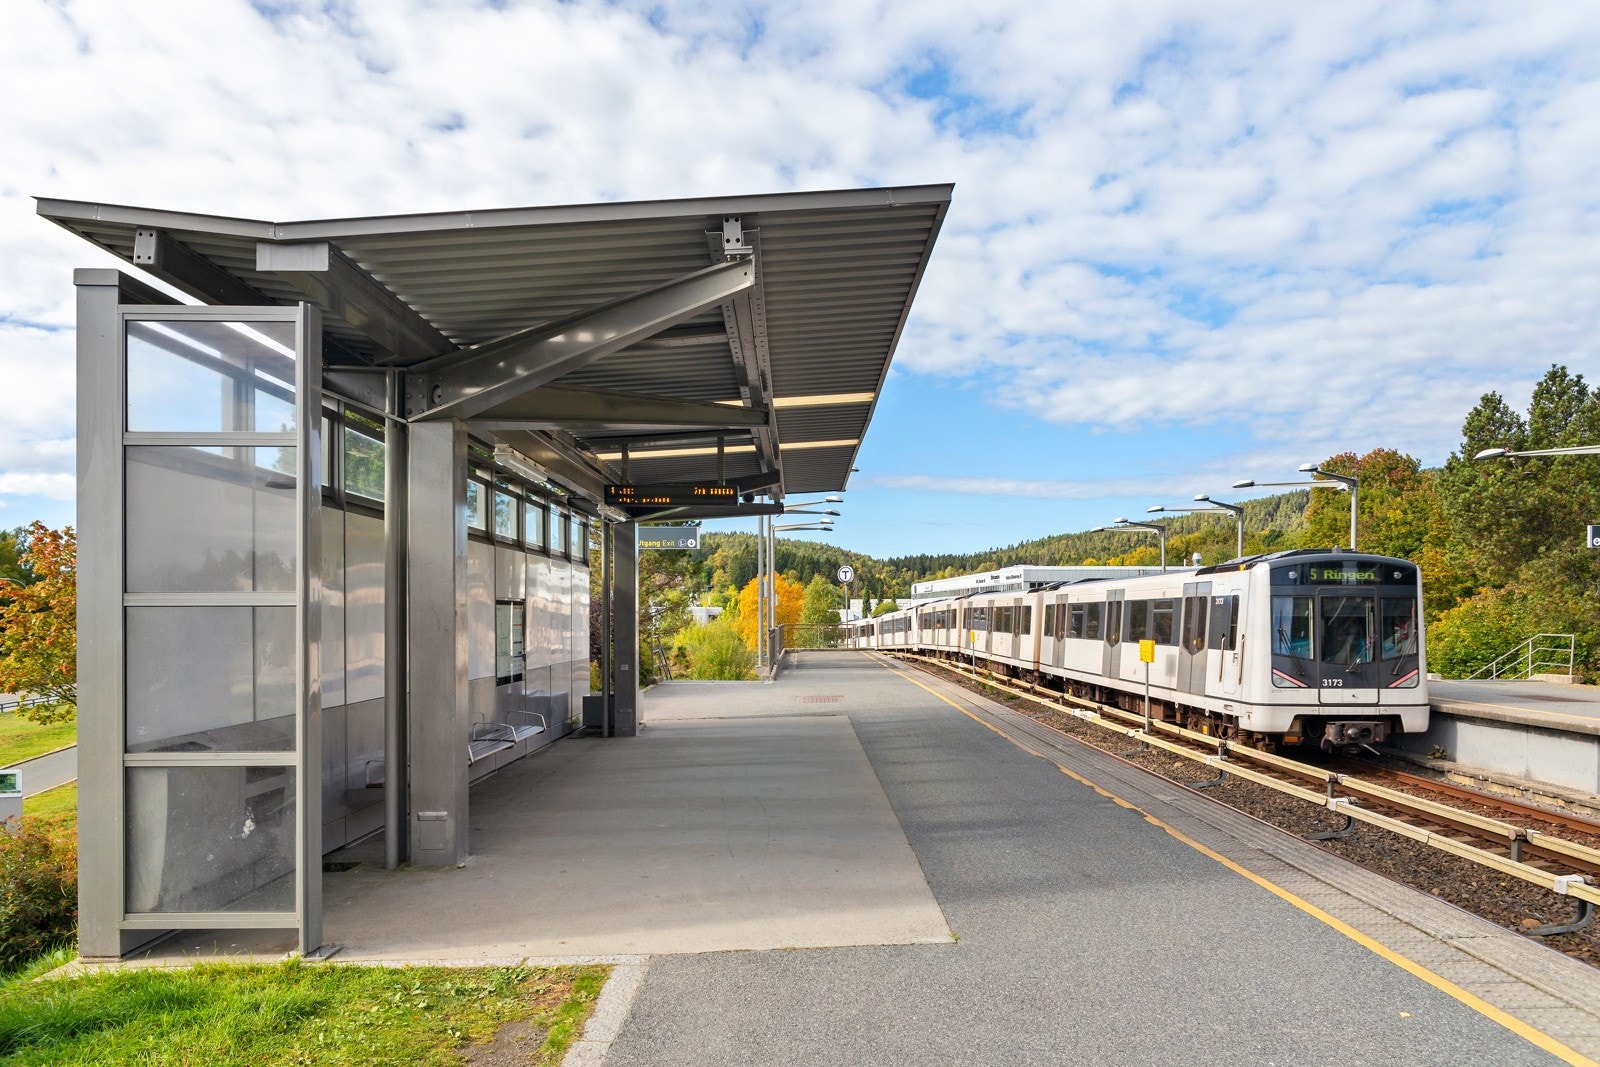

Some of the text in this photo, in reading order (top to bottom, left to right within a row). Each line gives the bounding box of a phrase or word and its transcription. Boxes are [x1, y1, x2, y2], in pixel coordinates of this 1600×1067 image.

[662, 539, 674, 547] Exit
[841, 570, 850, 580] T
[1310, 569, 1375, 580] 5 Ringen
[1322, 679, 1343, 687] 3173
